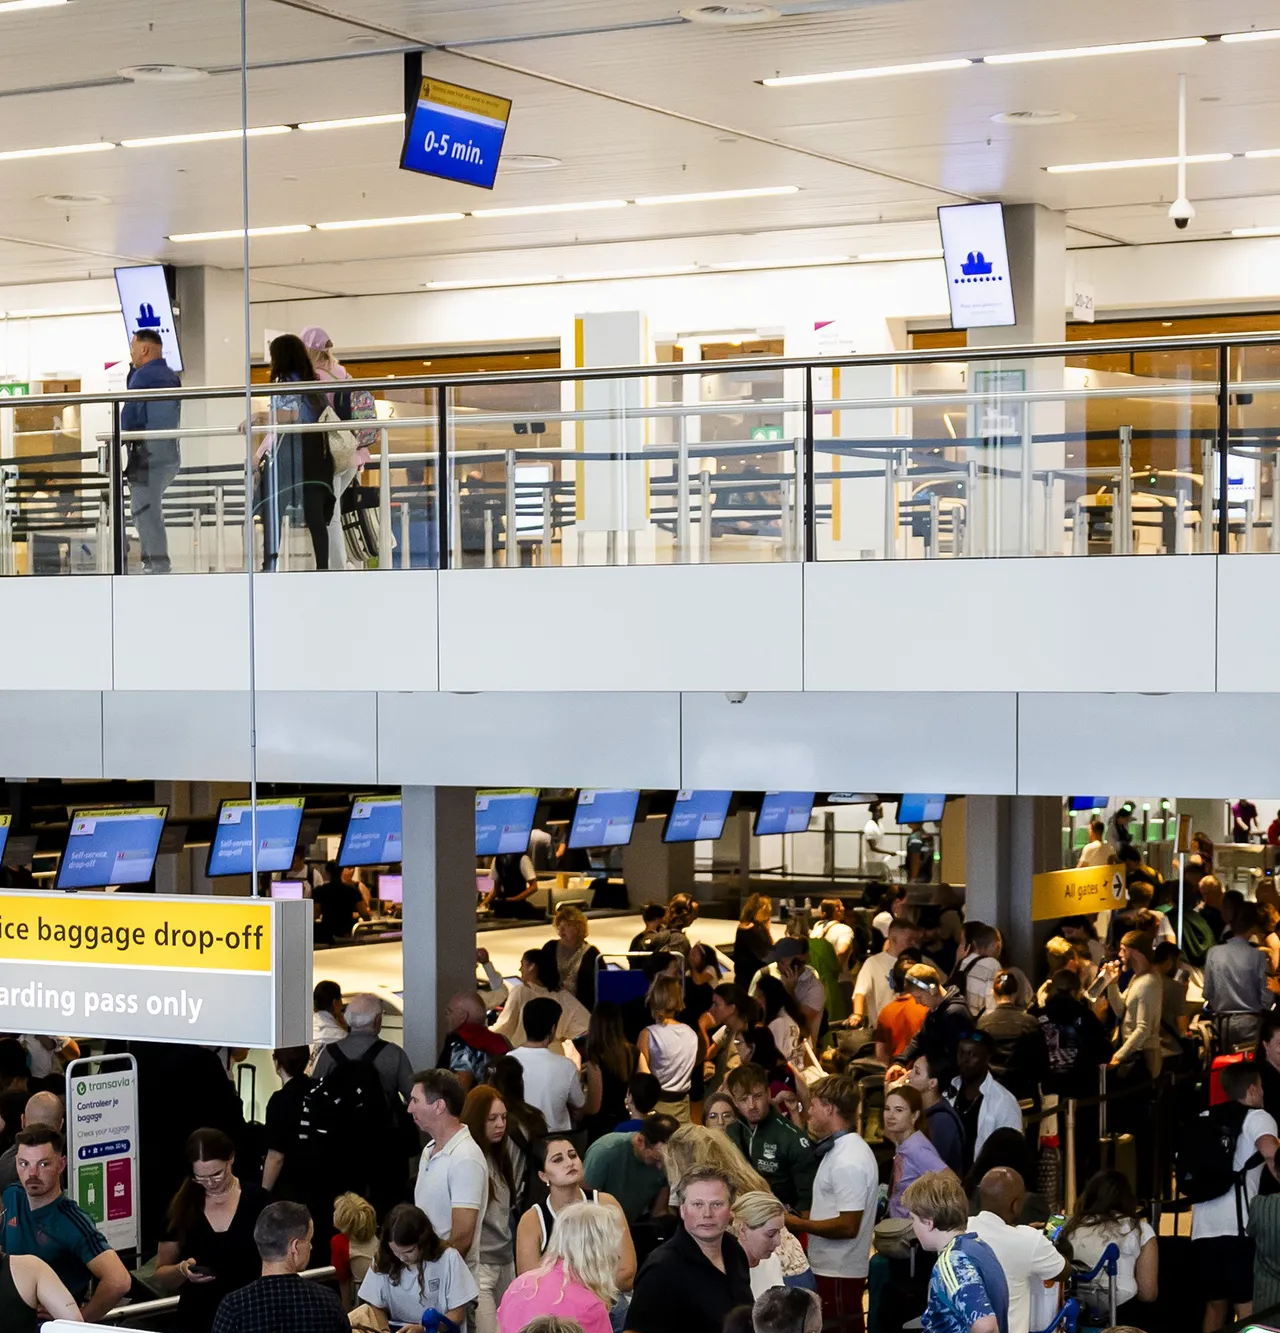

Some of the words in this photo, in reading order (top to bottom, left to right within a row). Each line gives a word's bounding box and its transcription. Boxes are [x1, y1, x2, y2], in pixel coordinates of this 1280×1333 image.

[424, 130, 450, 156] 0-5
[451, 139, 483, 165] min.
[2, 816, 8, 826] 3
[1064, 883, 1076, 898] All
[1078, 884, 1099, 901] gates
[37, 916, 146, 952] baggage
[154, 919, 264, 954] drop-off
[84, 990, 139, 1017] pass
[146, 989, 203, 1024] only
[89, 1077, 130, 1091] transavia
[77, 1099, 112, 1110] Controleer
[112, 1098, 119, 1108] je
[77, 1112, 103, 1123] bagage
[77, 1129, 94, 1138] Check
[95, 1128, 108, 1137] your
[108, 1125, 131, 1135] luggage
